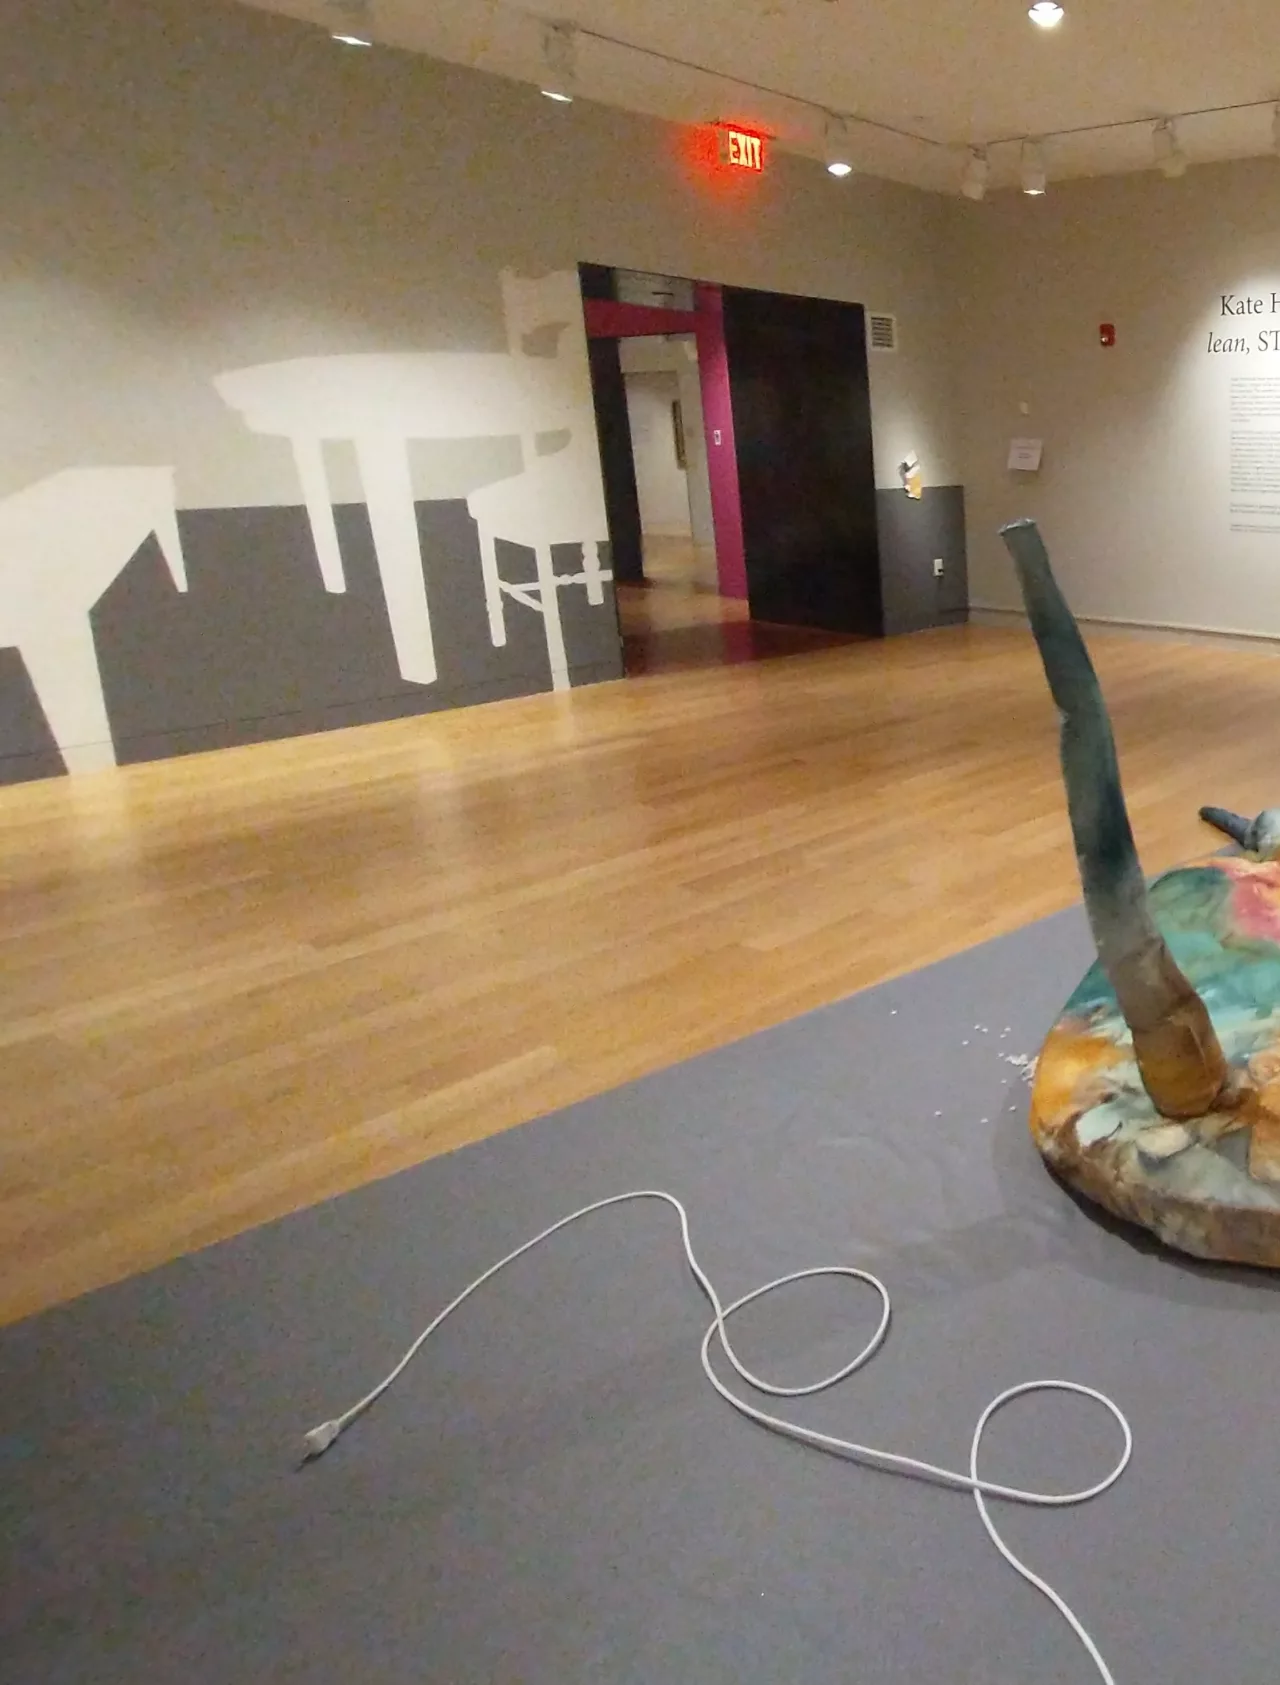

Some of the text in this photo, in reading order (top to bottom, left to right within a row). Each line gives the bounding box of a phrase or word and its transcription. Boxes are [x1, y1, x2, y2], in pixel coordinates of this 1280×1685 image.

[728, 130, 761, 170] EXIT
[1220, 294, 1263, 316] Kate
[1207, 331, 1250, 355] lean,
